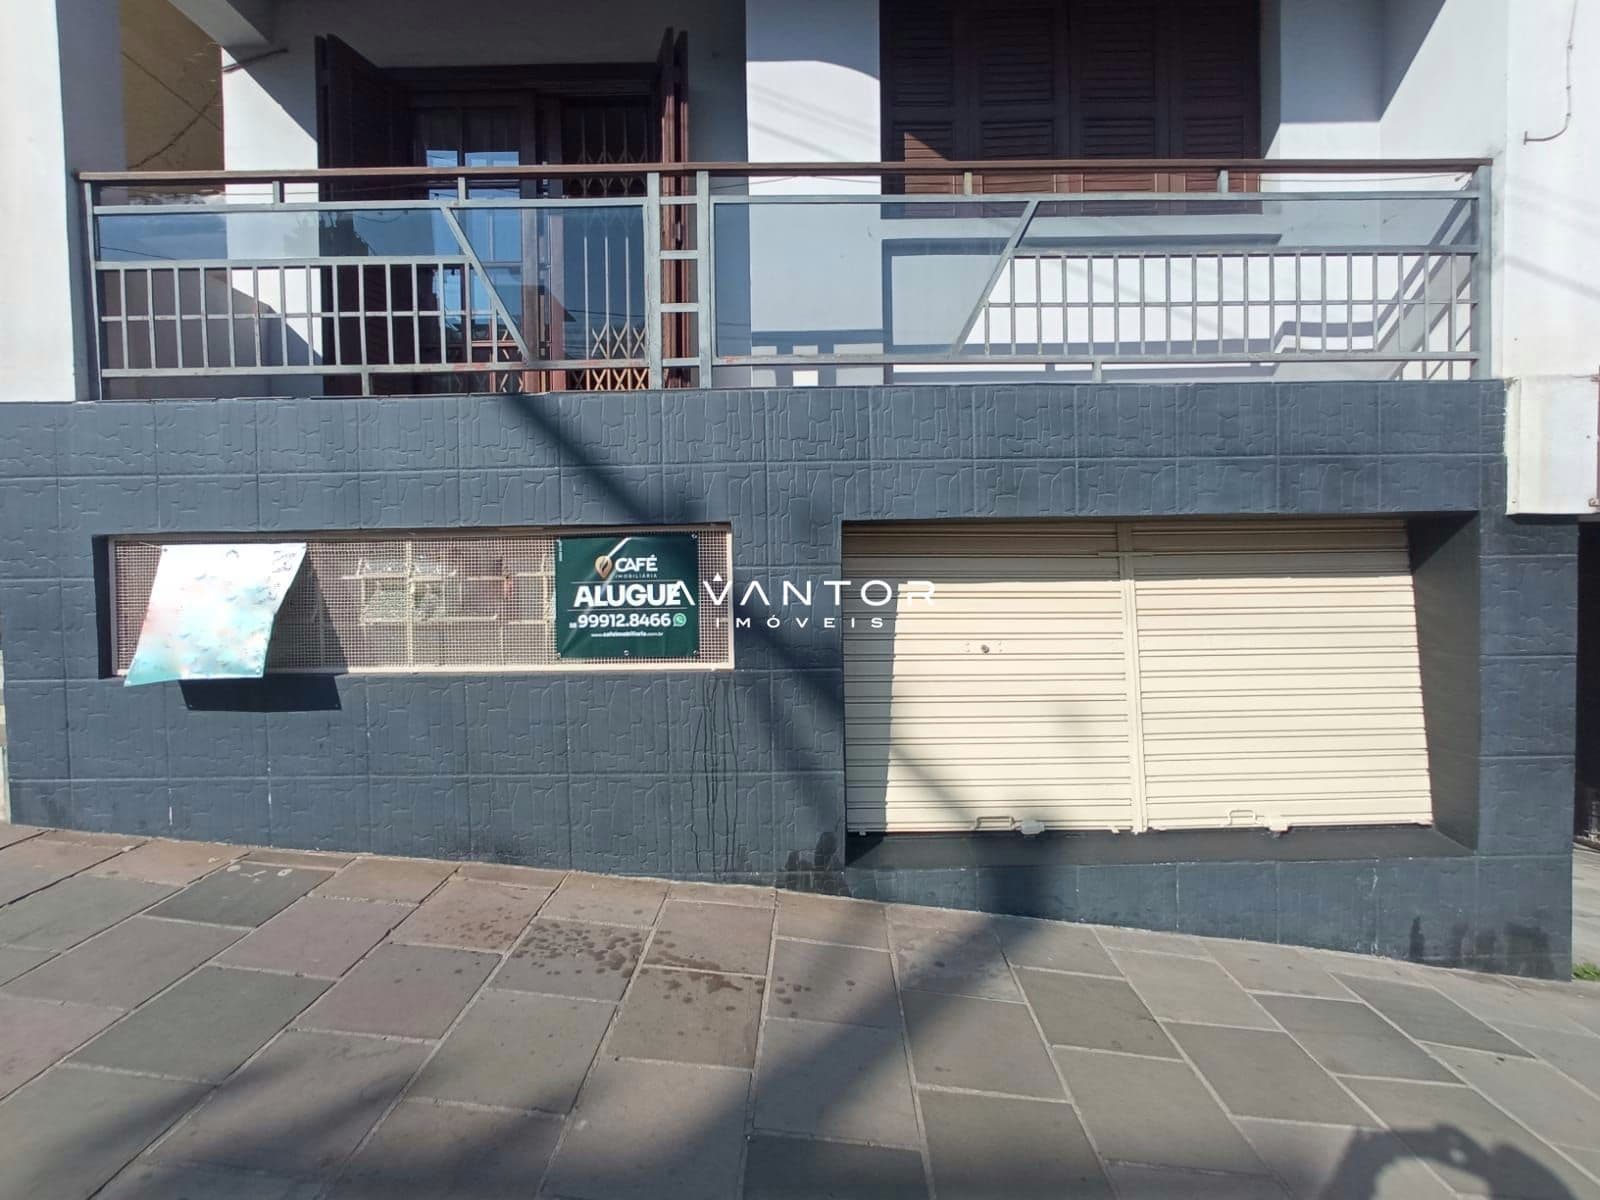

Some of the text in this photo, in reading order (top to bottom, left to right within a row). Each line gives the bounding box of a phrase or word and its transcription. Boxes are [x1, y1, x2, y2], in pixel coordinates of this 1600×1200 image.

[615, 554, 658, 572] CAFÉ
[574, 583, 681, 607] ALUGUE
[578, 613, 671, 628] 99912.8466
